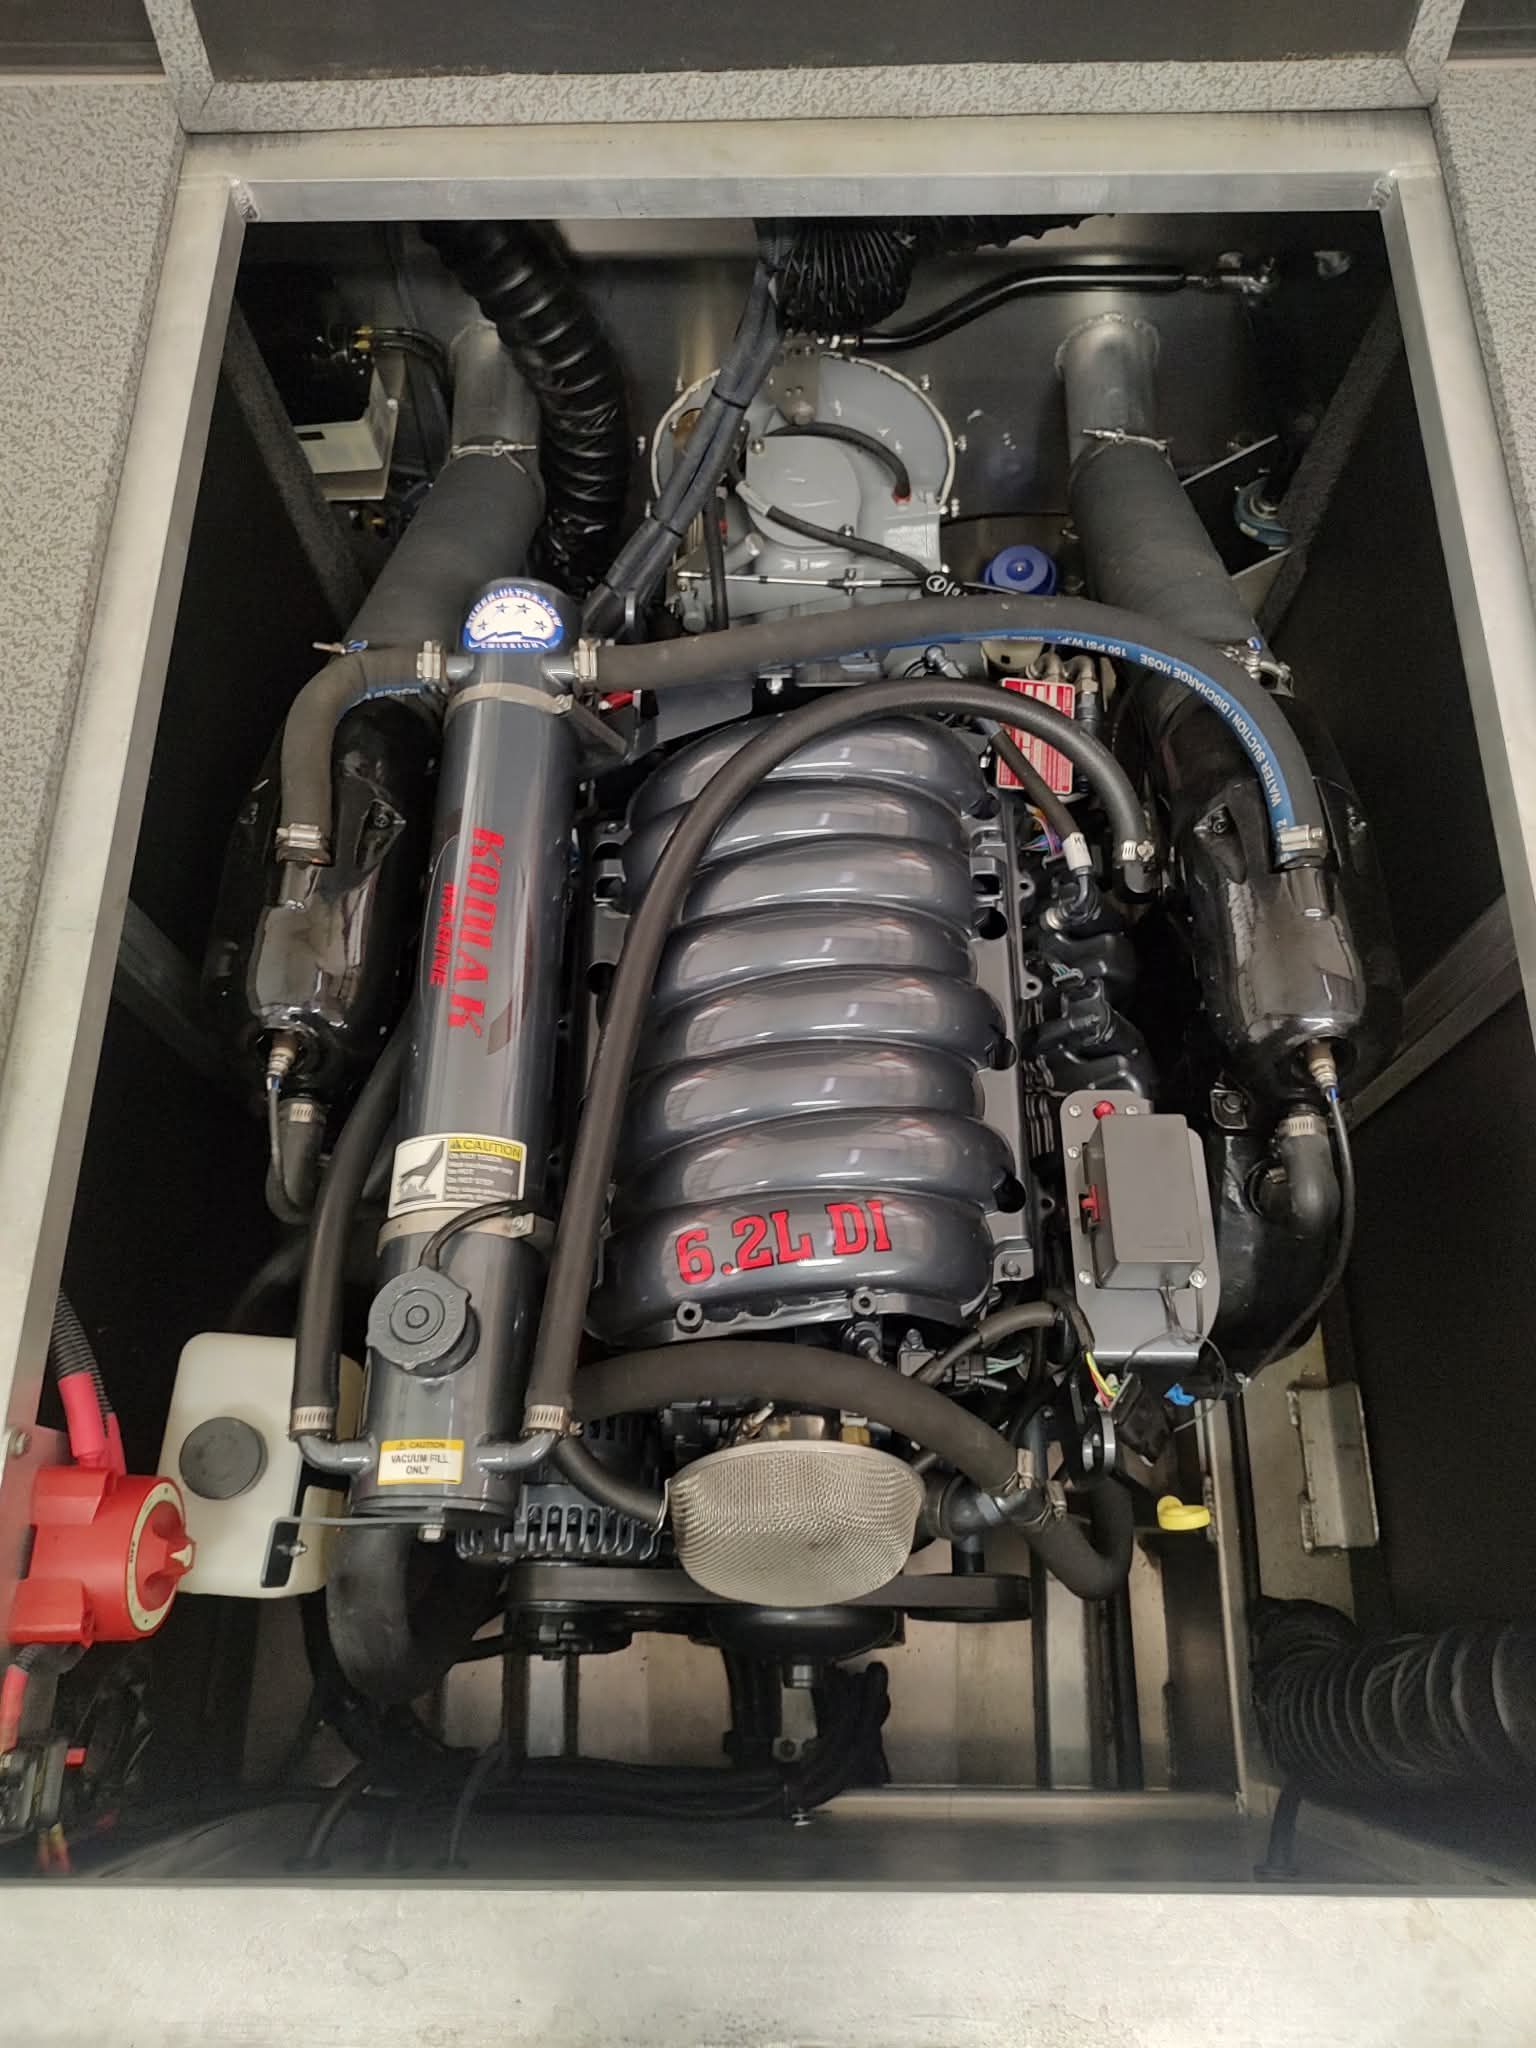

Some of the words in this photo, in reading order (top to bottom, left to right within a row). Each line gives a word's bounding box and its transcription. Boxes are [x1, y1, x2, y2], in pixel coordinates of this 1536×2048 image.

[1086, 639, 1106, 652] PSI
[1139, 653, 1172, 675] HOSE
[1173, 667, 1231, 714] DISCHARGE
[1231, 714, 1266, 762] SUCTION
[1261, 760, 1283, 807] WATER
[429, 881, 458, 988] MARINE
[447, 827, 505, 1037] KODIAK
[462, 1139, 522, 1157] CAUTION
[675, 1209, 815, 1285] 6.2L
[824, 1200, 893, 1256] DI
[391, 1454, 428, 1464] VACUUM
[429, 1454, 449, 1464] FILL
[408, 1441, 447, 1449] CAUTION
[405, 1465, 430, 1475] ONLY
